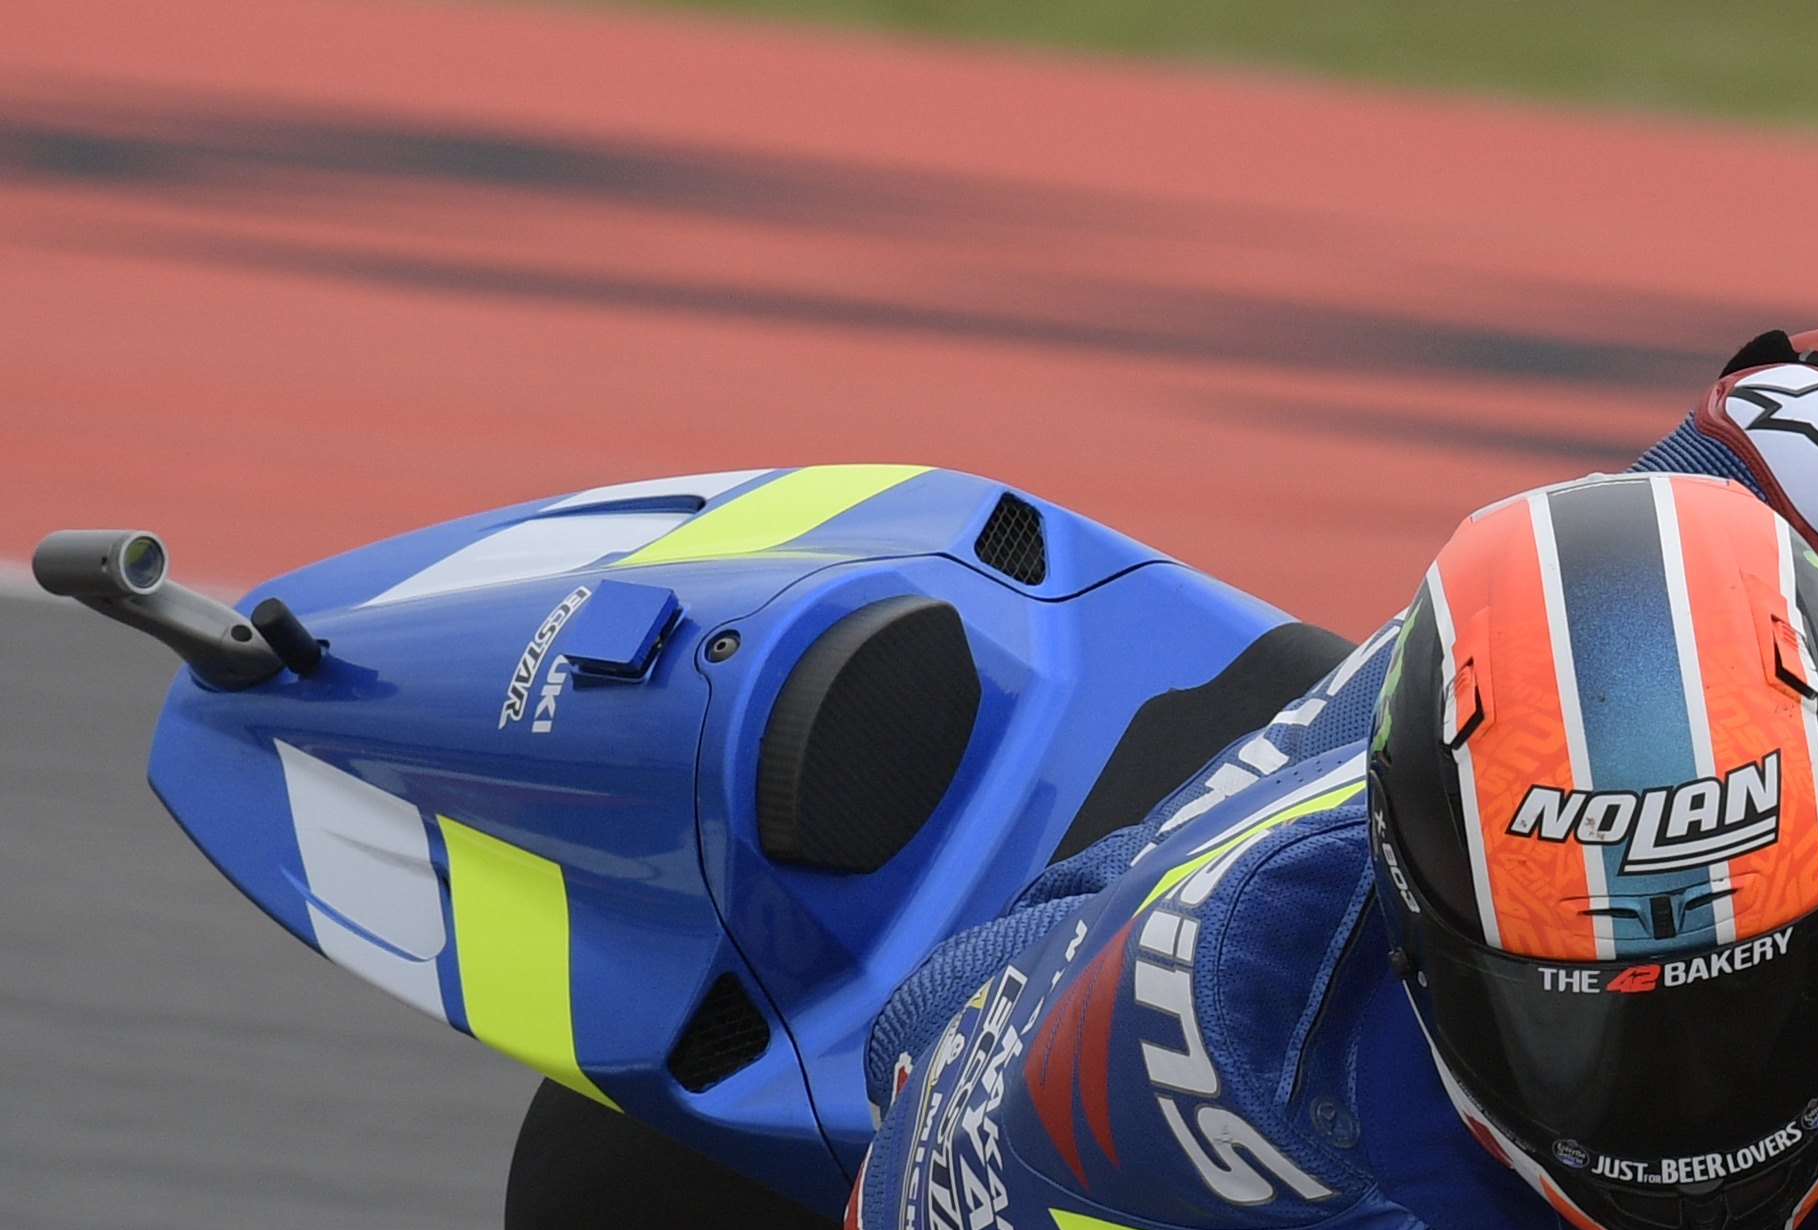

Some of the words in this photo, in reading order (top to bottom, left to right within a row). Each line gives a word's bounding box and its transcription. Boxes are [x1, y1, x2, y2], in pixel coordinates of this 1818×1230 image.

[498, 585, 593, 730] ECSTAR
[1506, 749, 1781, 876] NOLAN
[1538, 967, 1600, 993] THE
[1606, 963, 1661, 993] 42
[1664, 926, 1794, 987] BAKERY
[1592, 1155, 1648, 1183] JUST
[1644, 1173, 1661, 1184] FOR
[1661, 1153, 1726, 1184] BEER
[1728, 1121, 1803, 1174] LOVERS
